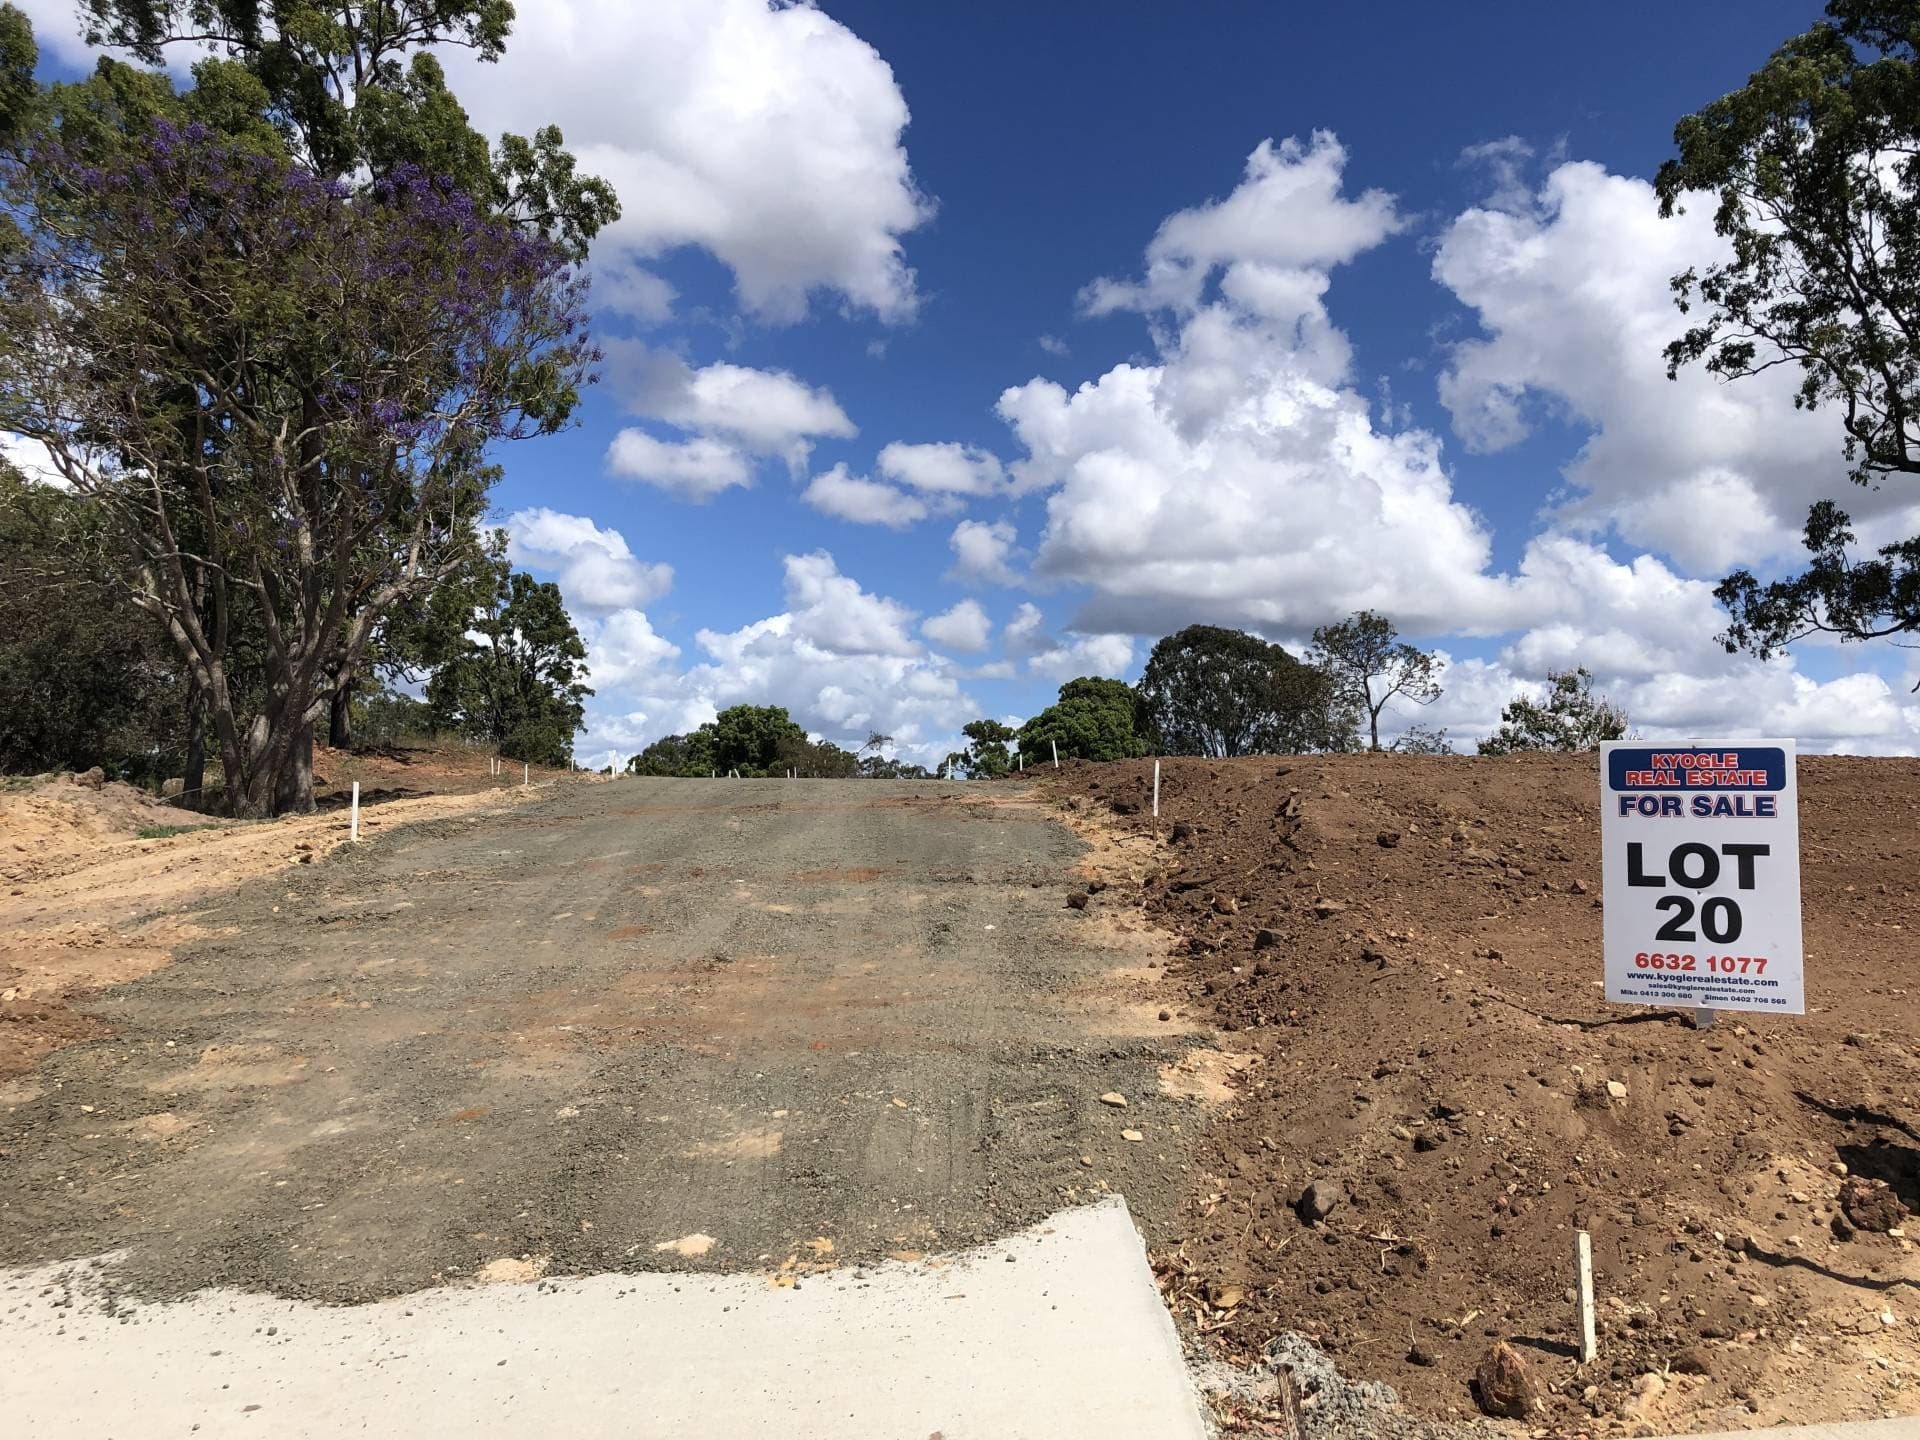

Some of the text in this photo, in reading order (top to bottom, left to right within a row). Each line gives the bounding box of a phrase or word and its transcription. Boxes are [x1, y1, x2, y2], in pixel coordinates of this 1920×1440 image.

[1651, 753, 1738, 769] KYOGLE
[1626, 770, 1767, 786] REAL ESTATE
[1618, 794, 1777, 818] FOR SALE
[1627, 842, 1770, 889] LOT
[1655, 895, 1742, 944] 20
[1635, 952, 1768, 975] 6632 1077
[1627, 972, 1779, 987] www.kyoglerealestate.com
[1704, 994, 1728, 1002] Simon
